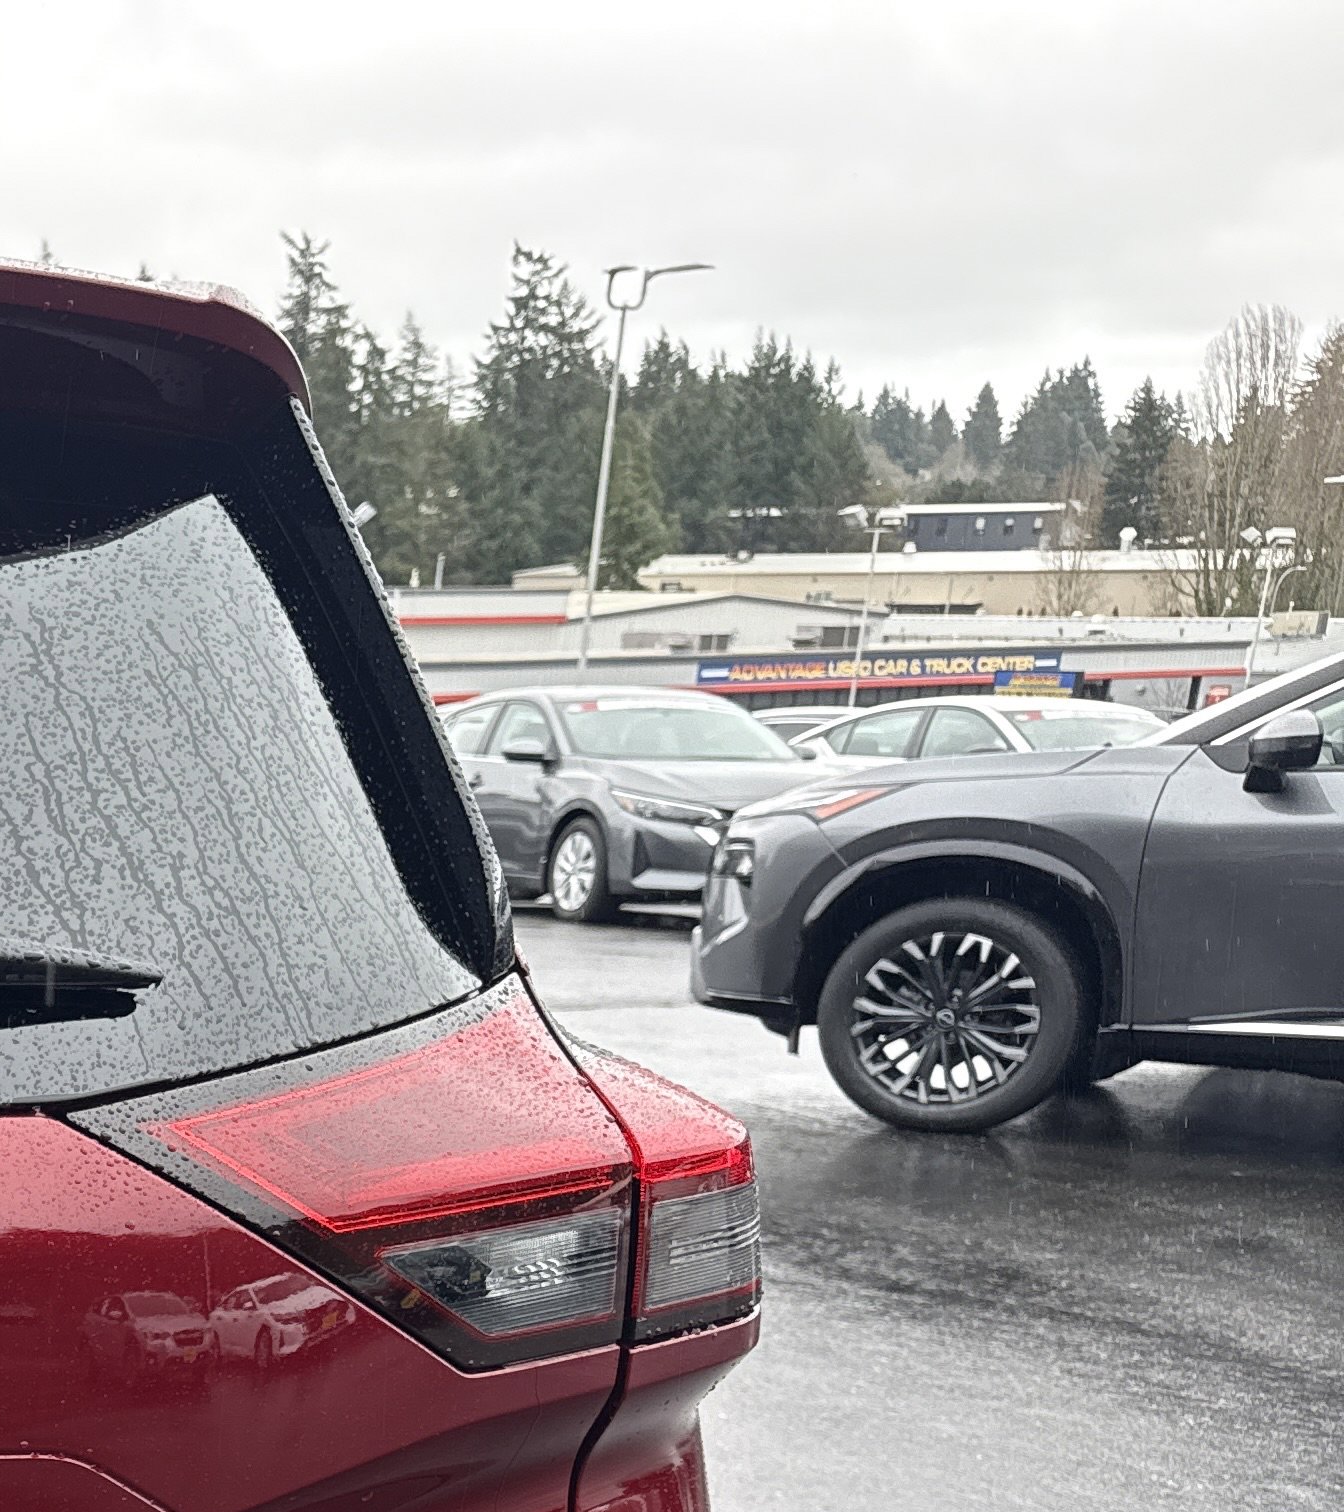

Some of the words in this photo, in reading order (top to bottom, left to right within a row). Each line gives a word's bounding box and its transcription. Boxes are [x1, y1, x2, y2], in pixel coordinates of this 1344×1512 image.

[729, 661, 826, 681] ADVANTAGE
[873, 658, 908, 675] CAR
[924, 656, 976, 674] TRUCK
[976, 655, 1035, 673] CENTER
